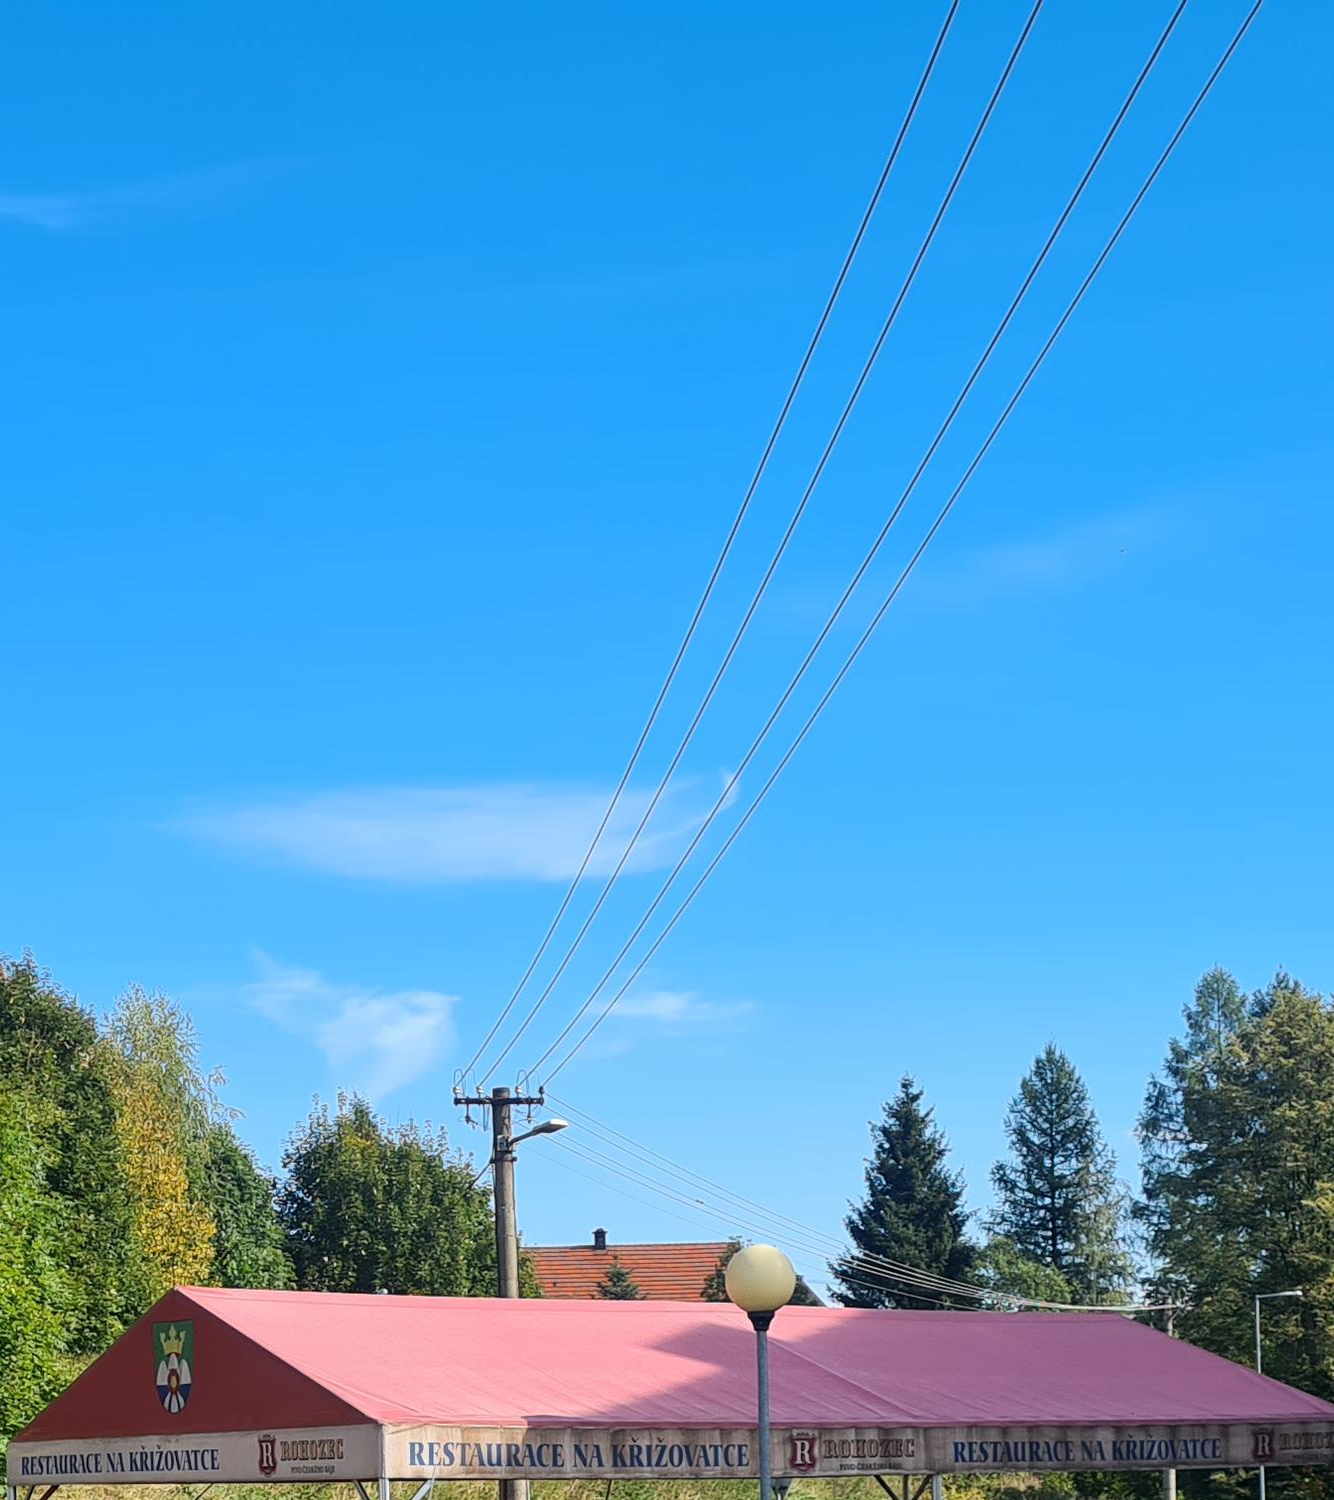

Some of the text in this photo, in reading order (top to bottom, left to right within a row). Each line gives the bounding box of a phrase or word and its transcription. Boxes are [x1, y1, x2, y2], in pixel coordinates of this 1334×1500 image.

[21, 1444, 220, 1476] RESTAURACE NA KŘIŽOVATCE
[280, 1439, 344, 1461] ROHOZEC
[408, 1437, 750, 1468] RESTAURACE NA KŘIŽOVATCE
[795, 1440, 812, 1465] R
[823, 1438, 915, 1459] ROHOZEC
[953, 1433, 1222, 1464] RESTAURACE NA KŘIŽOVATCE
